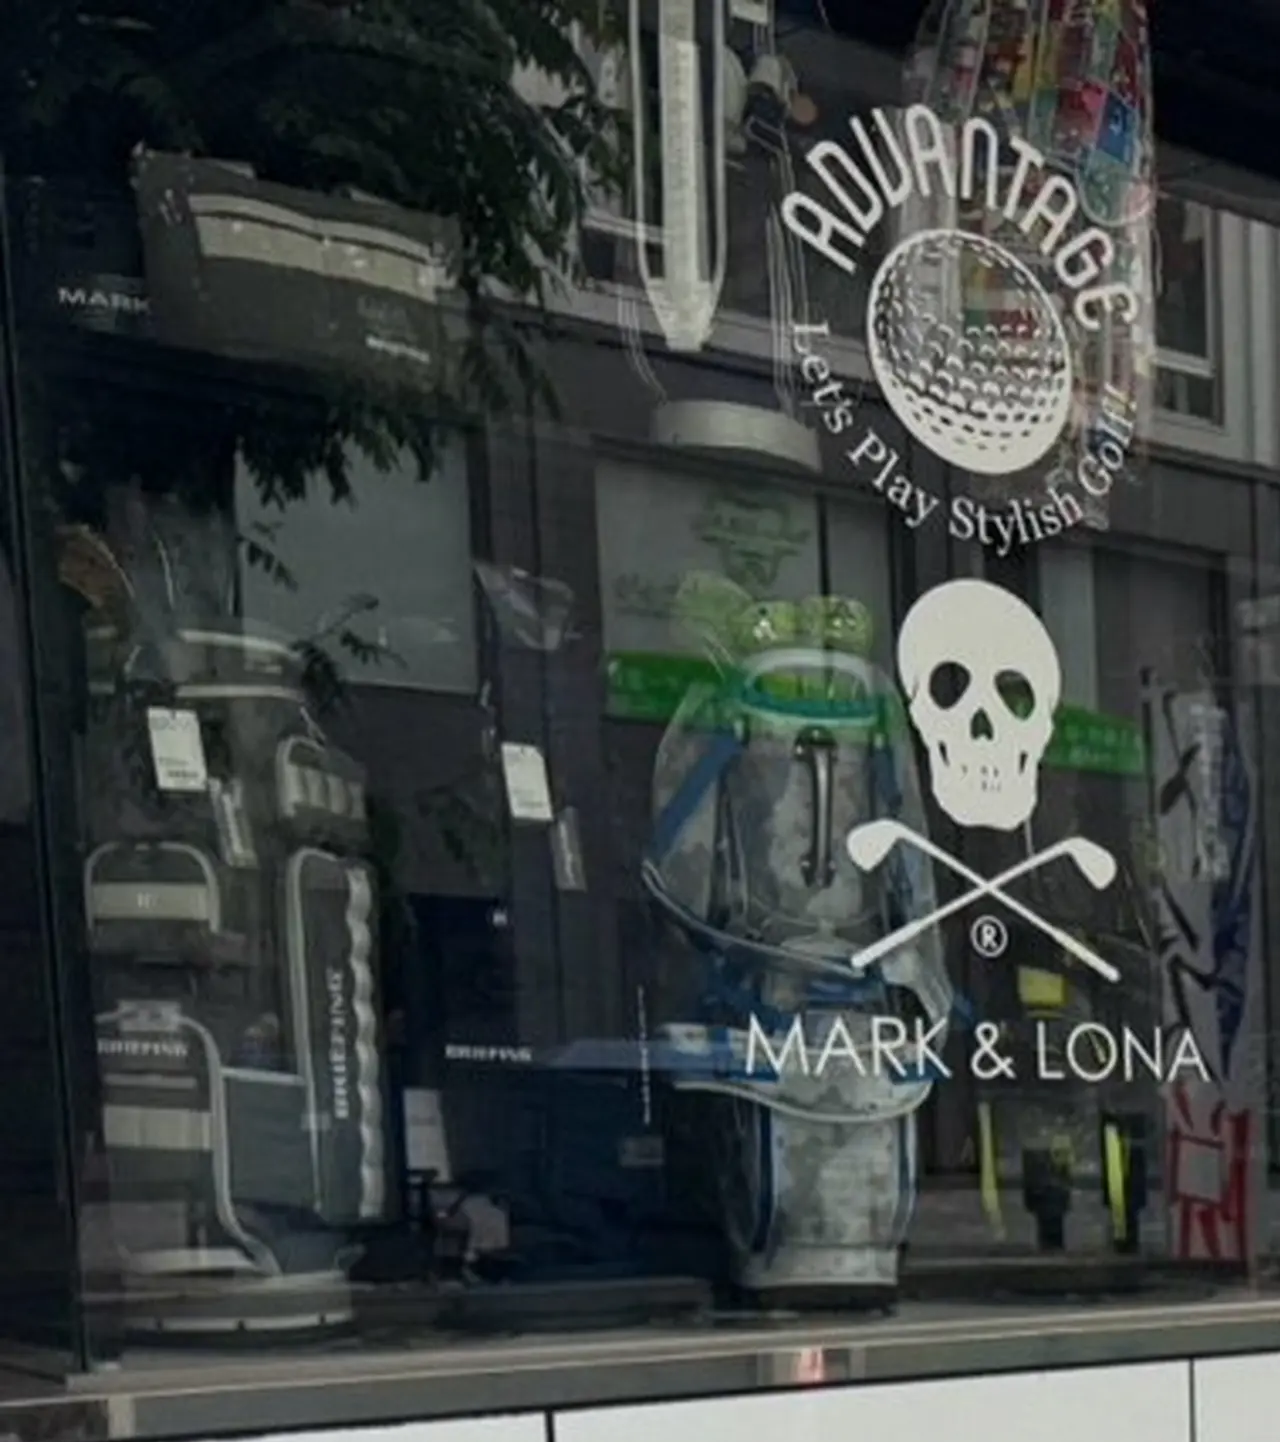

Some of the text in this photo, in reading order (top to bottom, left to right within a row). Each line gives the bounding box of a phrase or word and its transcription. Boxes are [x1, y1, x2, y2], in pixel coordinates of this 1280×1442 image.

[781, 103, 1138, 331] ADVANTAGE
[793, 323, 854, 435] Let's
[848, 431, 940, 529] Play
[948, 488, 1084, 556] Stylish
[745, 1014, 1210, 1083] MARK & LONA
